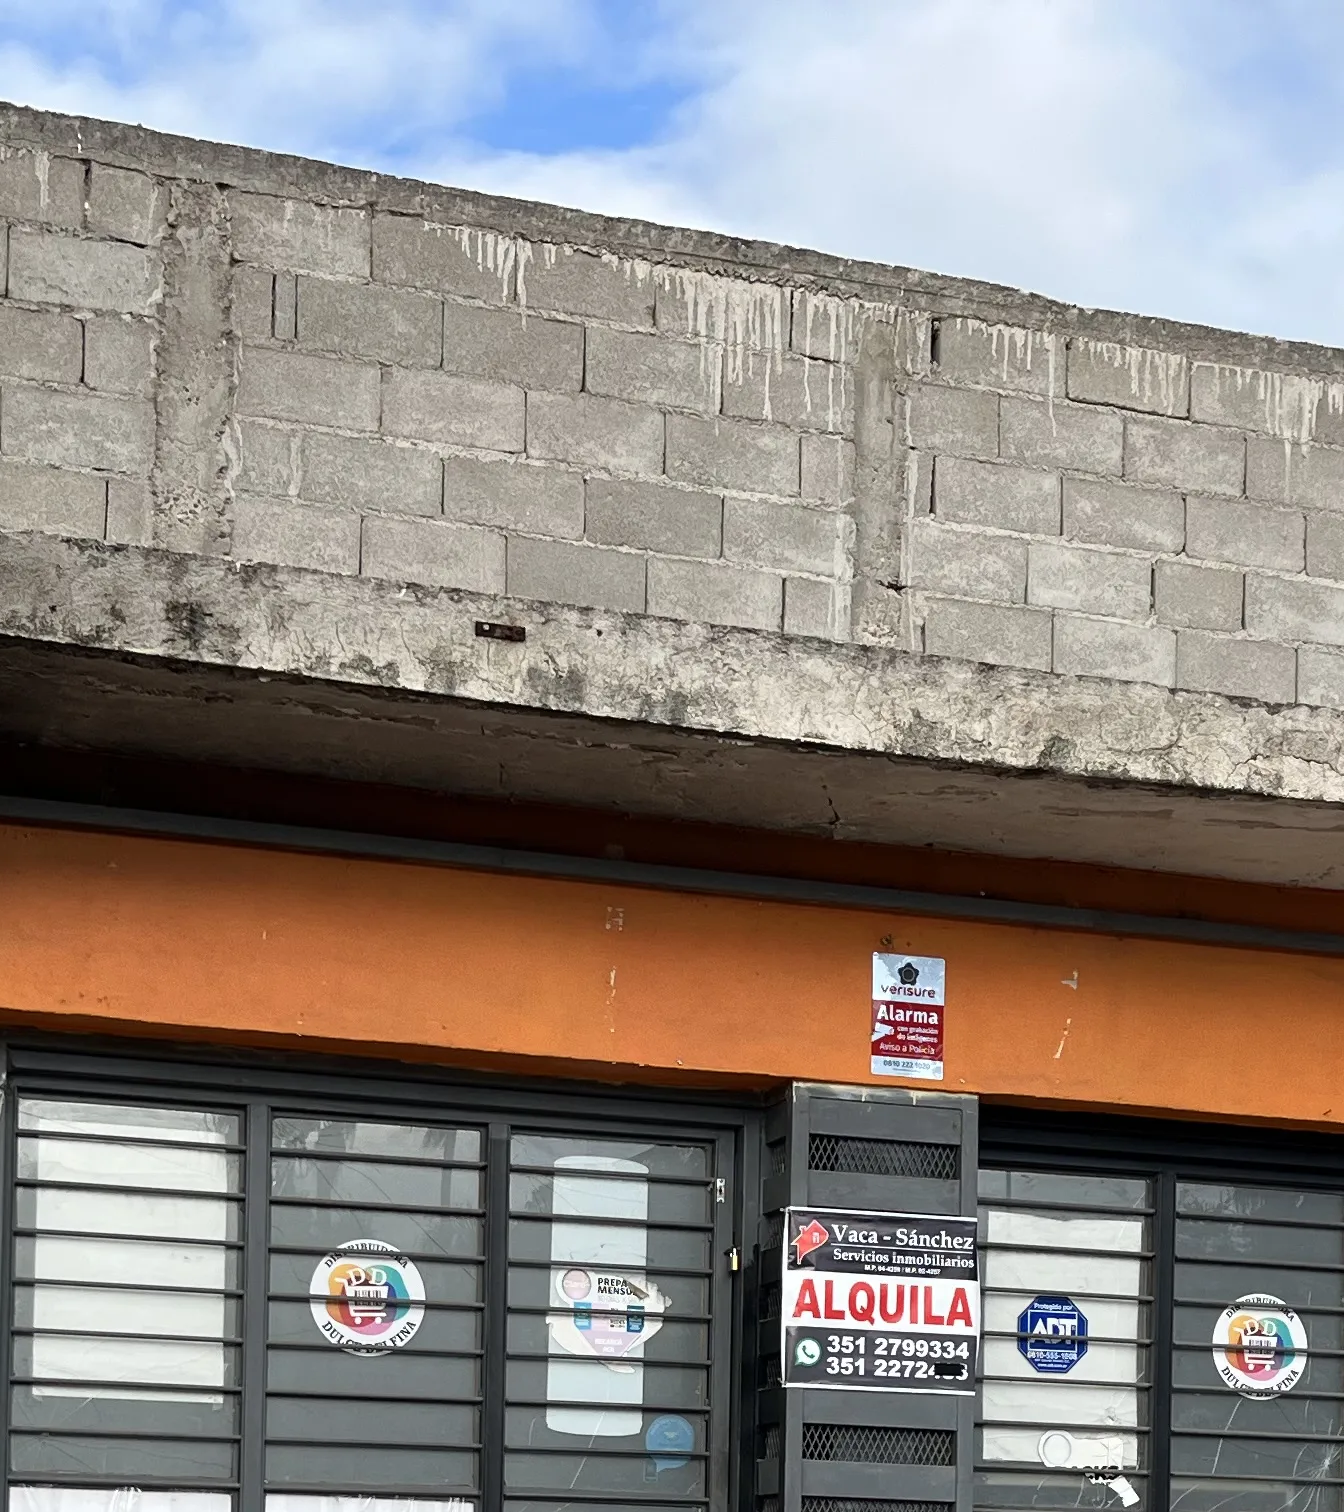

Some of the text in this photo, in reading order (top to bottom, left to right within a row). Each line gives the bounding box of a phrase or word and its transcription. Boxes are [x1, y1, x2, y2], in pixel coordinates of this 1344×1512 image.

[880, 984, 936, 998] verisure
[876, 1004, 939, 1025] Alarma
[879, 1042, 901, 1052] Aviso
[831, 1223, 878, 1243] Vaca
[896, 1228, 974, 1250] Sánchez
[833, 1248, 975, 1268] Servicios inmobiliarios
[597, 1286, 636, 1295] MENSU
[792, 1278, 973, 1327] ALQUILA
[1029, 1317, 1076, 1345] ADT
[826, 1335, 970, 1359] 351 2799334
[826, 1356, 865, 1376] 351
